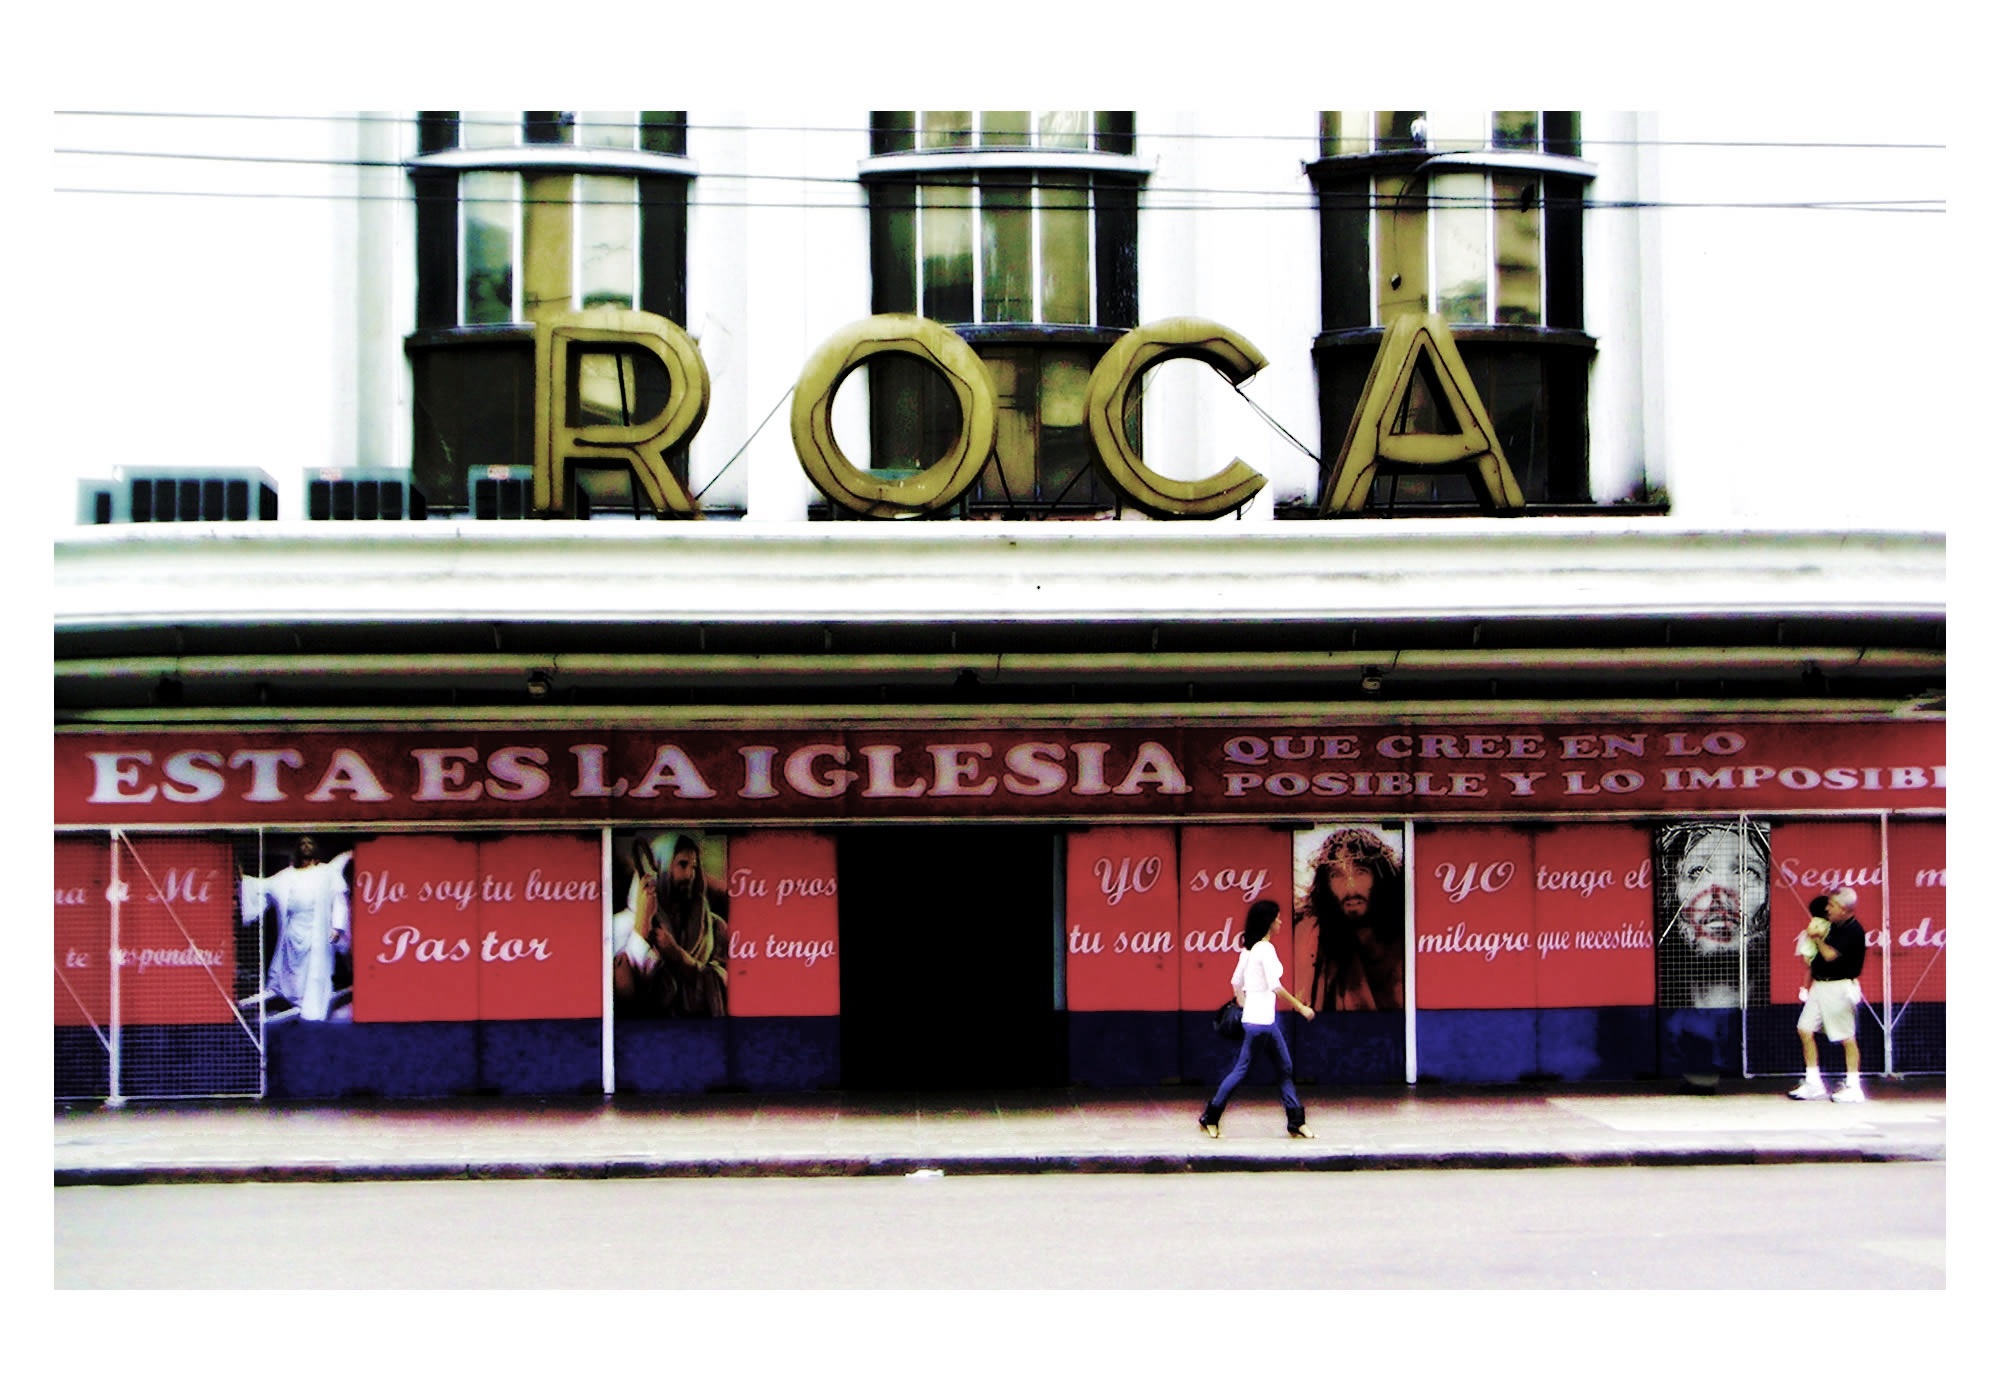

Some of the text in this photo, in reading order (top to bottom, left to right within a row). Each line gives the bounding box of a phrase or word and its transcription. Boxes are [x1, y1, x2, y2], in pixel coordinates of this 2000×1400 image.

[533, 310, 1526, 519] ROCA
[1223, 731, 1747, 765] QUE CREE EN LO
[86, 741, 1193, 803] ESTA ES LA IGLESIA
[1223, 771, 1489, 798] POSIBLE
[1500, 771, 1547, 796] Y
[1562, 768, 1646, 795] LO
[356, 868, 600, 915] Yo soy tu buen
[728, 867, 769, 898] Tu
[1094, 855, 1272, 906] YO soy
[1434, 858, 1653, 903] YO tengo el
[728, 930, 837, 969] la tengo
[1069, 923, 1105, 955] tu
[1417, 919, 1654, 963] milagro que necesitás
